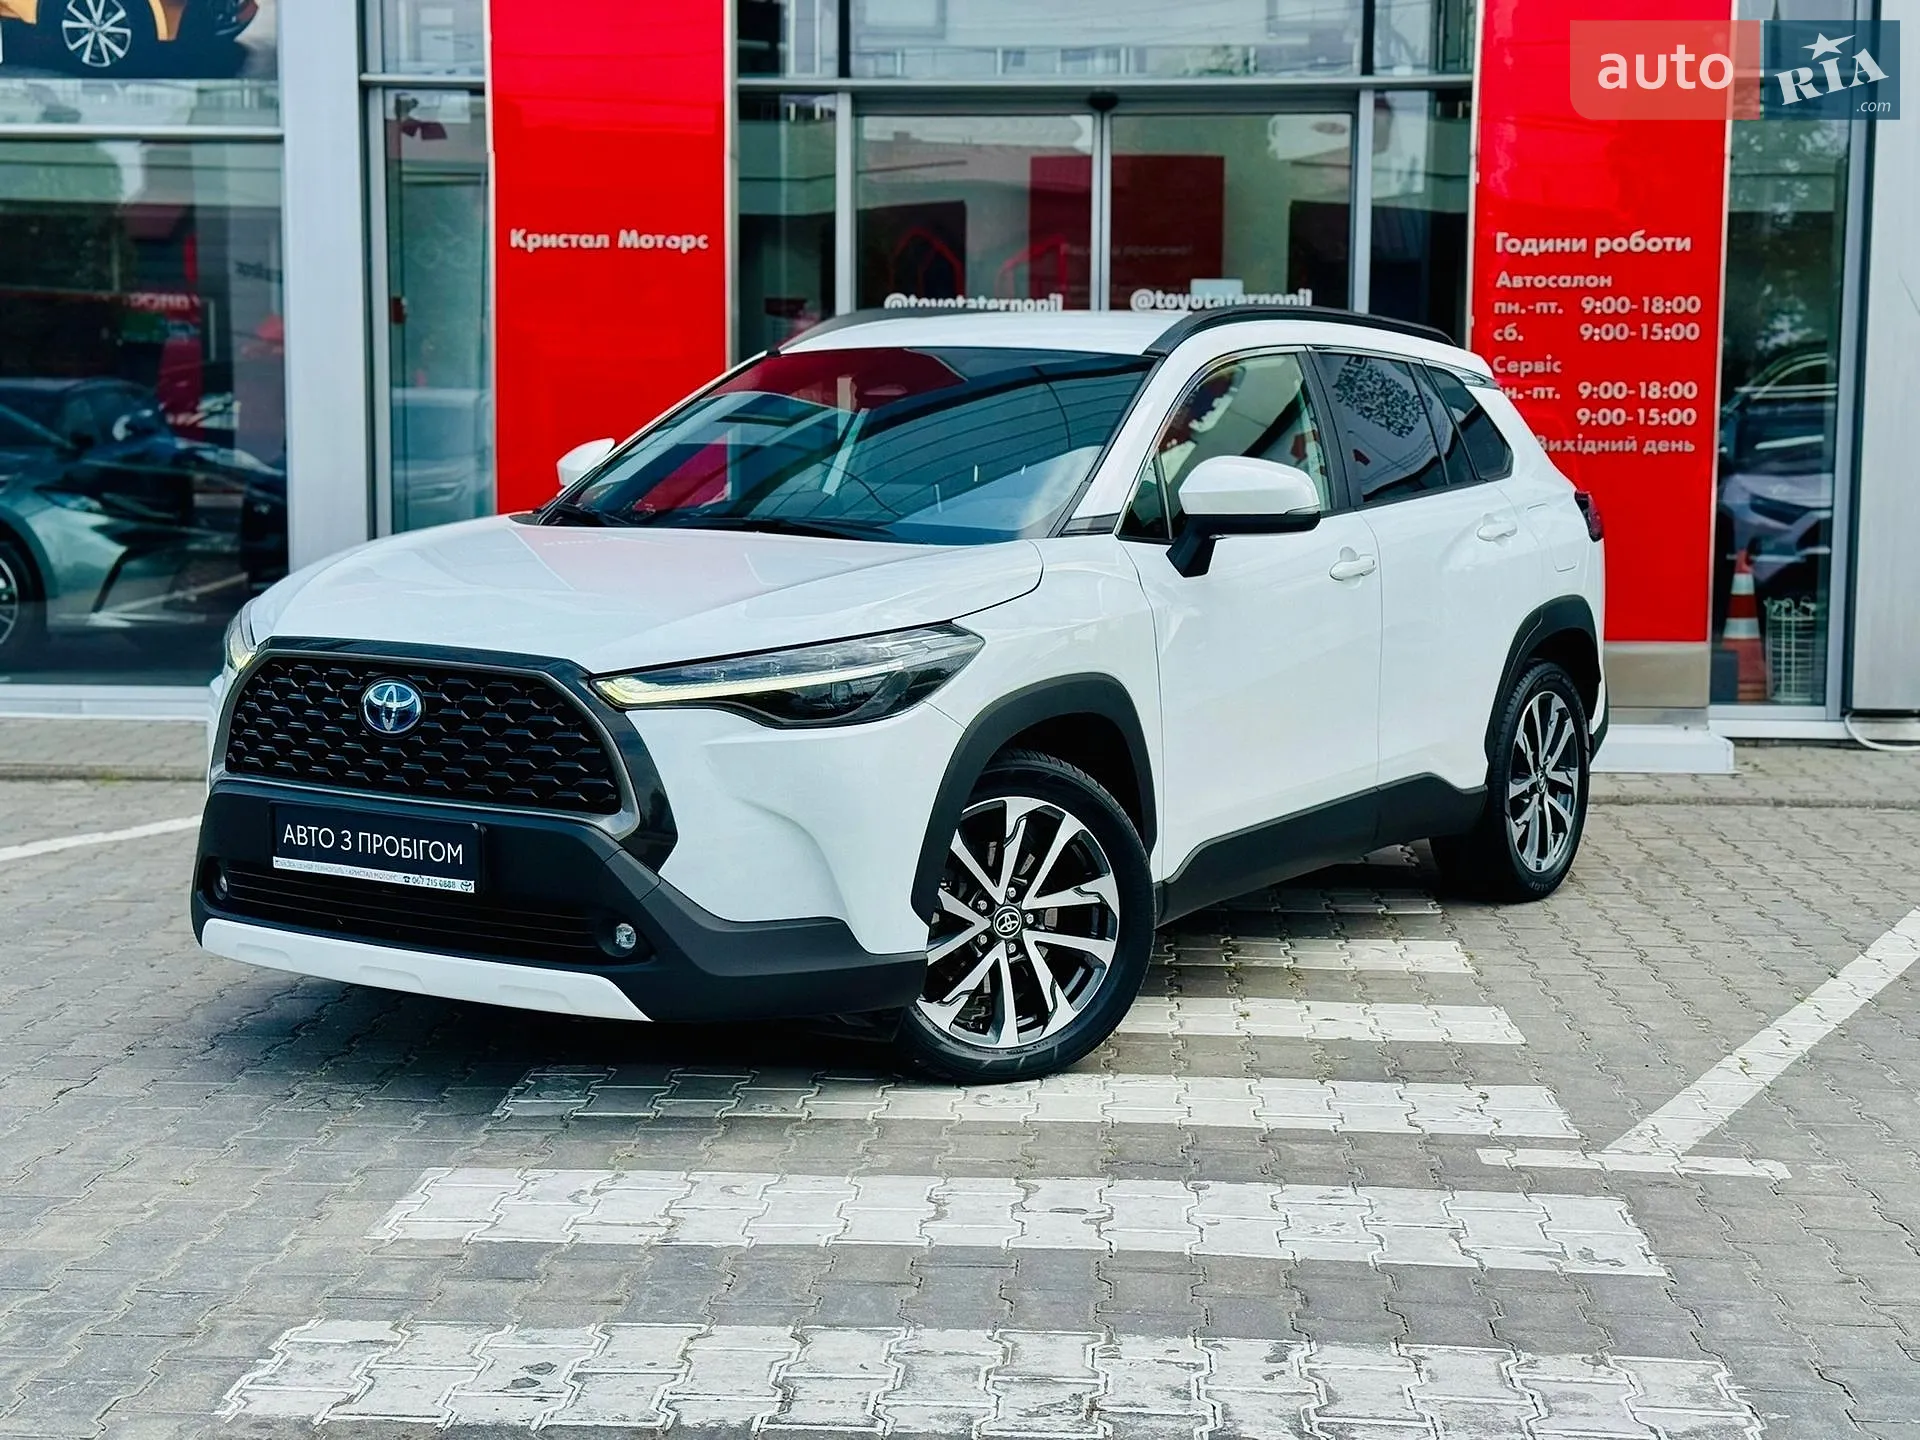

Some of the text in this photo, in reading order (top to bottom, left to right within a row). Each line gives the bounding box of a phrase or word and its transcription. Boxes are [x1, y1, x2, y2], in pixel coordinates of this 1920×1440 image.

[509, 228, 709, 254] Кристал Моторс
[1495, 229, 1692, 258] Години роботи
[1495, 270, 1613, 288] Автосалон
[1493, 301, 1564, 315] пн.-пт.
[1493, 322, 1524, 341] сб.
[1493, 354, 1562, 378] Сервіс
[1643, 439, 1696, 455] день
[283, 823, 463, 865] АВТО З ПРОБІГОМ
